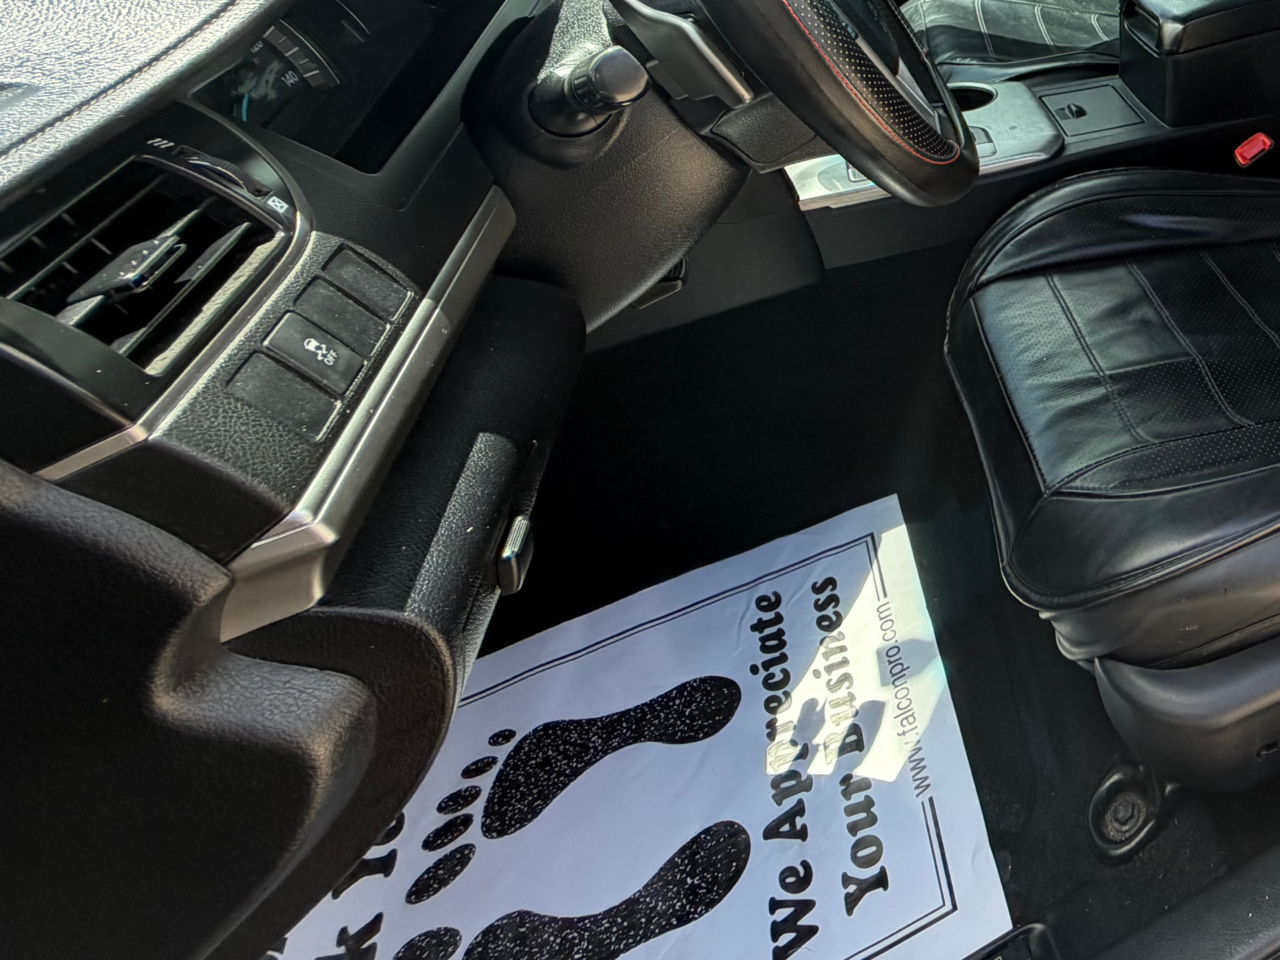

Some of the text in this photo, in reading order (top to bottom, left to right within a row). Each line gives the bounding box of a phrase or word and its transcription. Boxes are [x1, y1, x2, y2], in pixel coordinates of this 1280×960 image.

[281, 70, 299, 87] 140
[324, 349, 338, 366] OFF
[750, 591, 820, 960] We Appreciate
[811, 576, 889, 917] Your Business
[876, 601, 931, 798] www.falconpro.com
